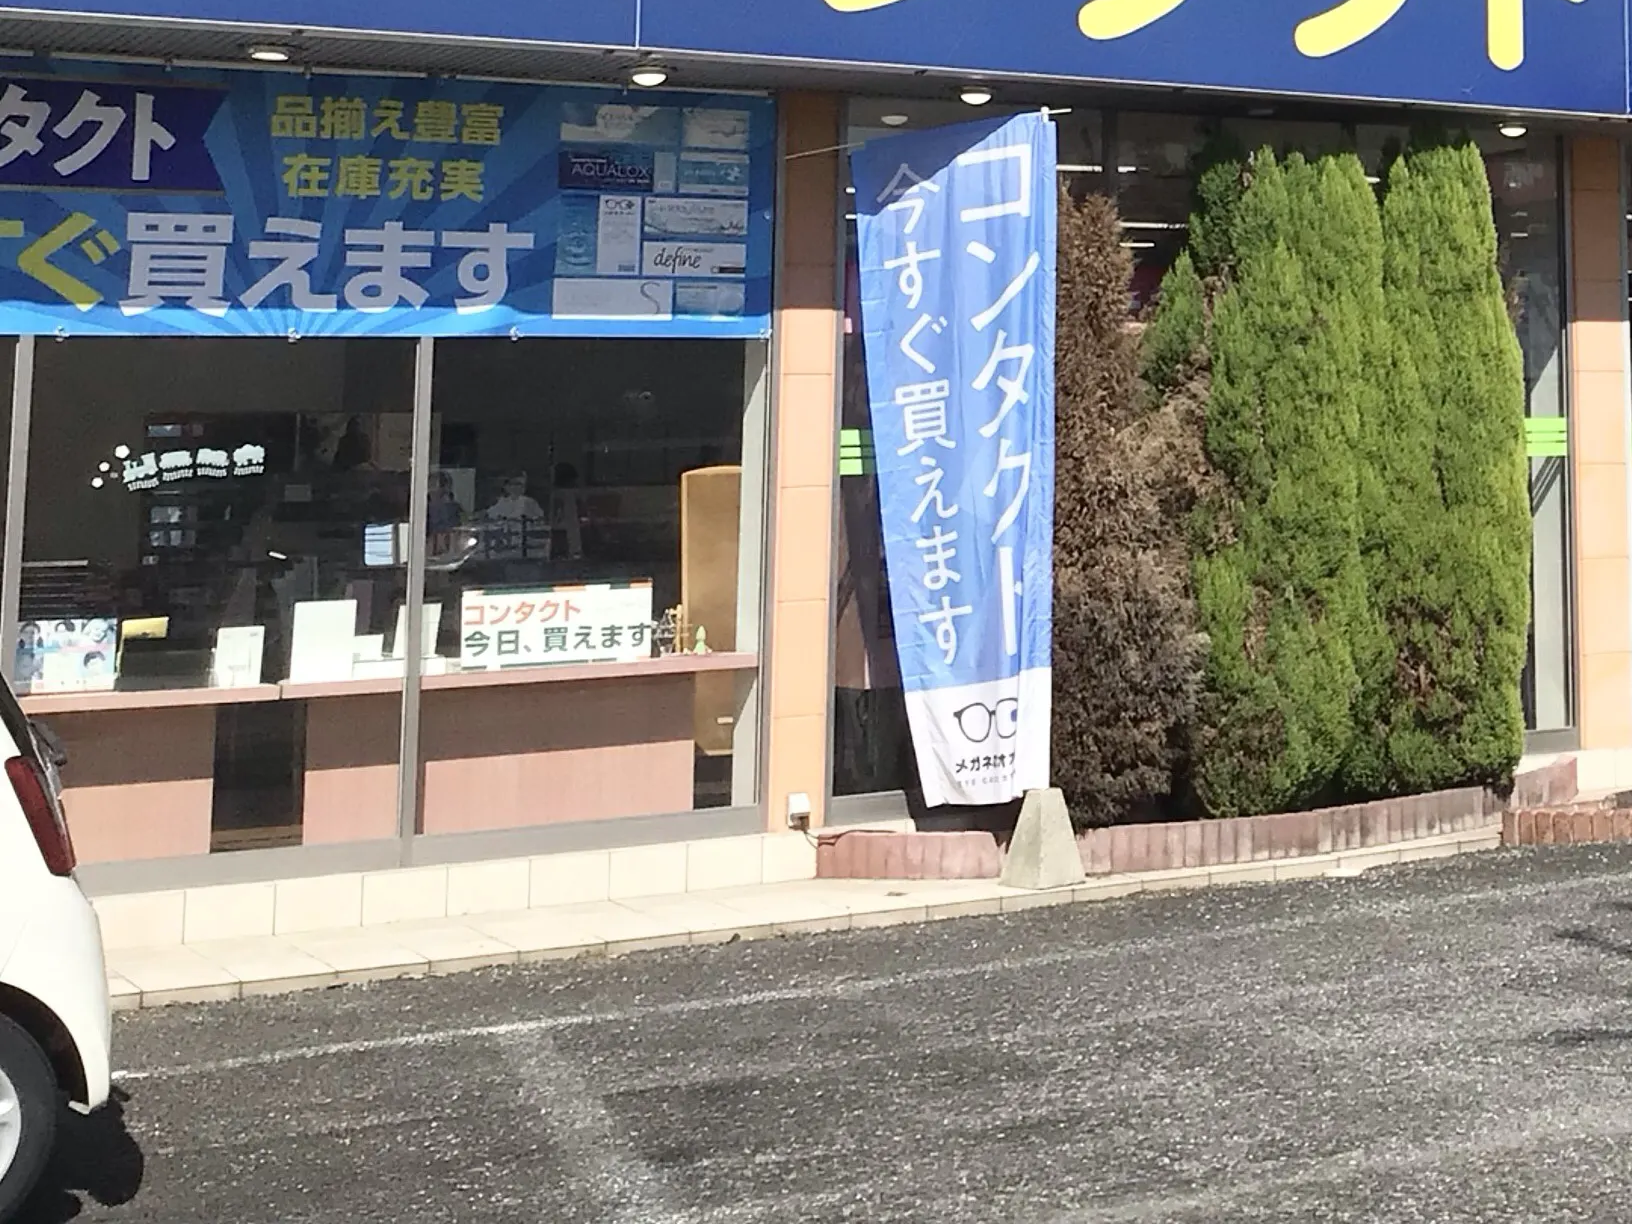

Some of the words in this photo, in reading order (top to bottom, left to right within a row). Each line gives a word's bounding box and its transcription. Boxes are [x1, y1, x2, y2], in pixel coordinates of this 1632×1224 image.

[272, 95, 504, 146] 品揃え豊富
[281, 153, 485, 203] 在庫充実
[653, 246, 703, 274] define
[876, 162, 973, 665] 今すぐ買えます
[464, 599, 581, 626] コンタクト
[464, 622, 652, 658] 今日、買えます
